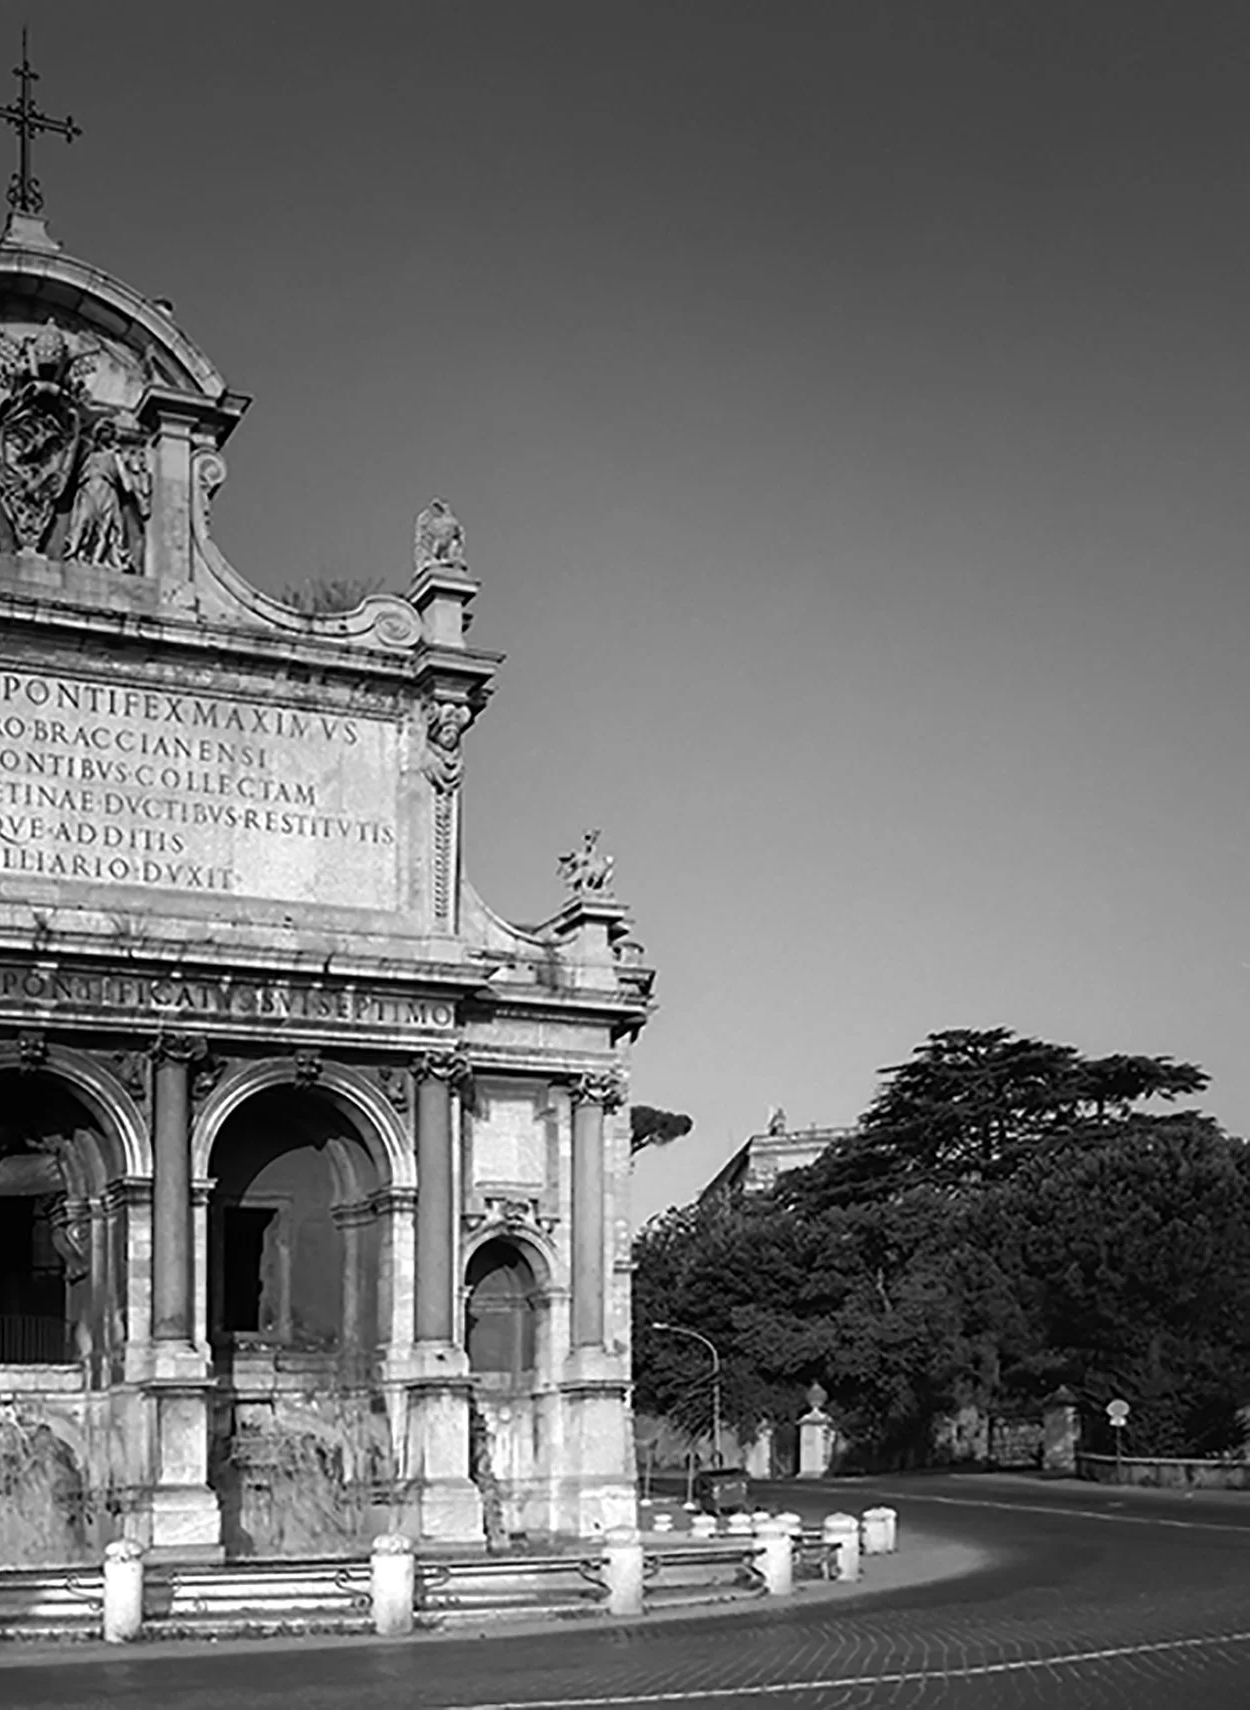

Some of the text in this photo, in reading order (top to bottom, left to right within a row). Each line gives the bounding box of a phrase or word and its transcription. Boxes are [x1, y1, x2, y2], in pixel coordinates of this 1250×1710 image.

[4, 675, 184, 725] PONTIFEX
[191, 700, 359, 745] MAXIMVS
[33, 719, 266, 770] BRACCIANENSI
[135, 765, 316, 806] COLLECTAM
[54, 821, 185, 855] ADDITIS
[105, 793, 237, 827] DVCTIBVS
[244, 809, 394, 845] RESTITVTIS
[143, 862, 235, 891] DVXIT
[317, 992, 452, 1025] SEPTIMO
